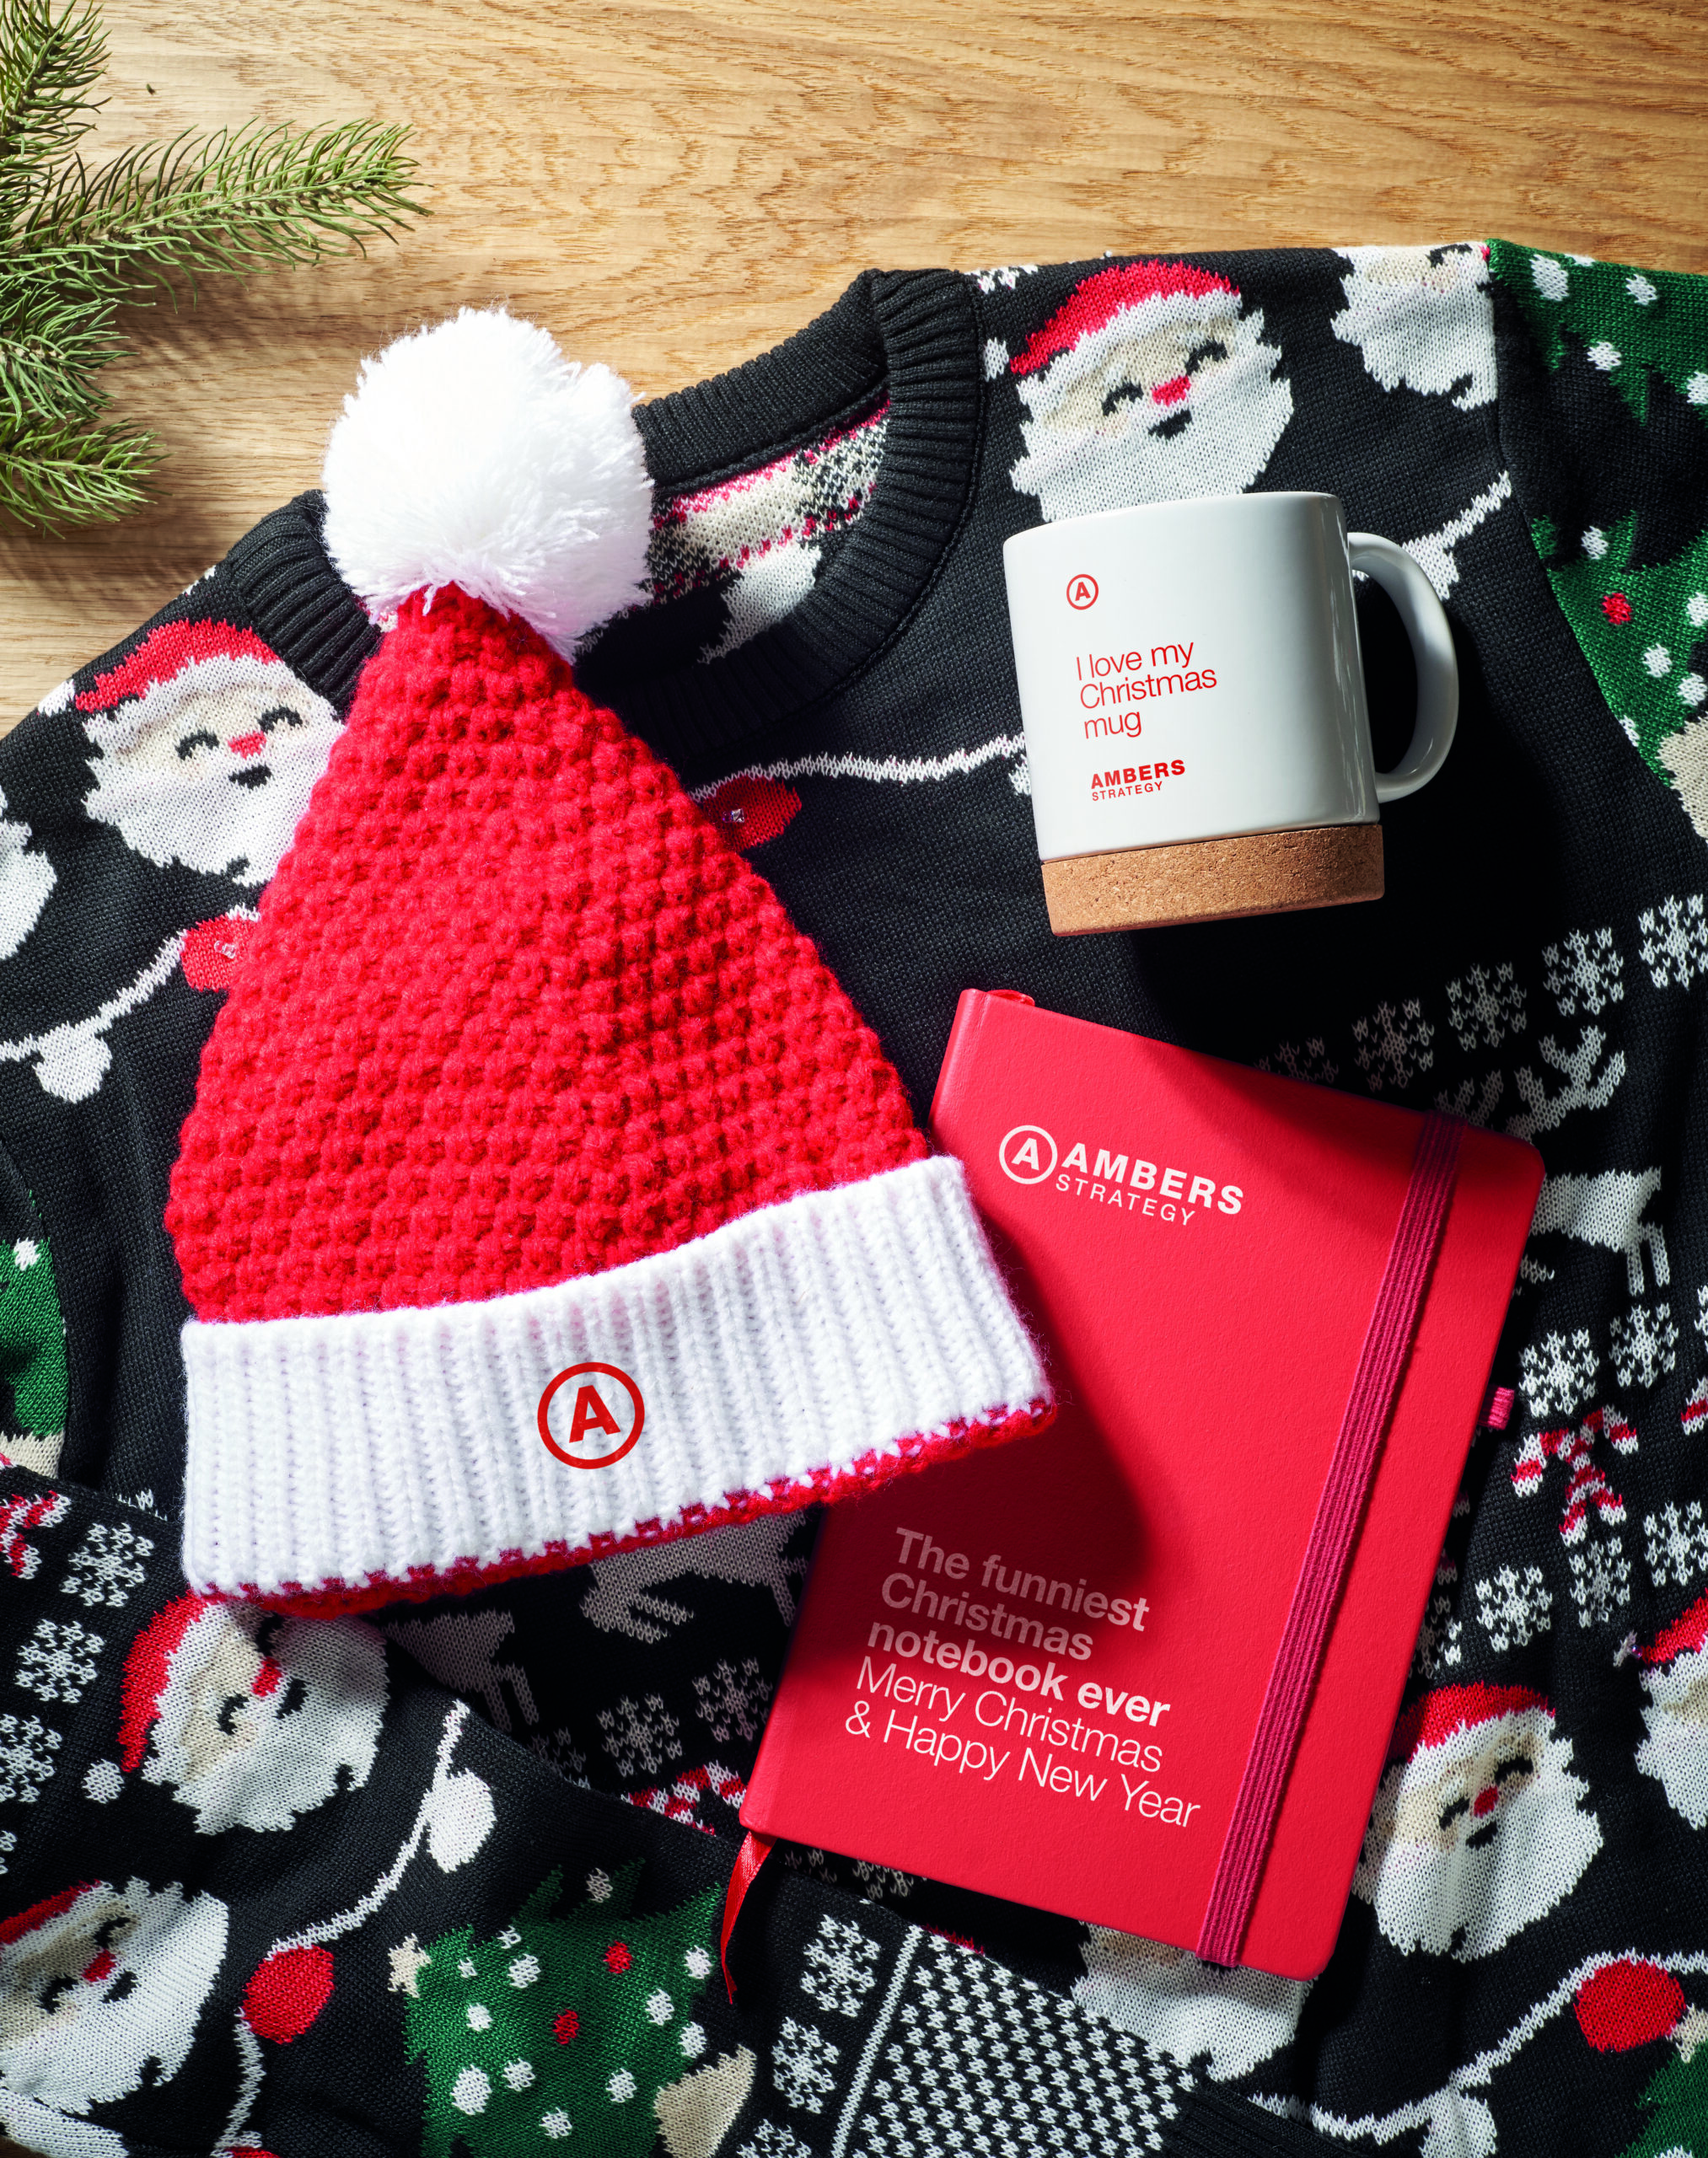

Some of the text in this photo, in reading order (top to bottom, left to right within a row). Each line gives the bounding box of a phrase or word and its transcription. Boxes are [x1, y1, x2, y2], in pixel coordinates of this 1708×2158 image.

[1077, 641, 1195, 680] I love my
[1080, 668, 1217, 709] Christmas
[1084, 711, 1142, 739] mug
[1091, 760, 1186, 790] AMBERS
[1092, 781, 1163, 802] STRATEGY
[1055, 1173, 1195, 1226] STRATEGY
[1061, 1142, 1243, 1215] AMBERS
[895, 1527, 1150, 1632] The funniest
[882, 1572, 1094, 1661] Christmas
[867, 1622, 1171, 1727] notebook ever
[856, 1656, 1163, 1773] Merry Christmas
[845, 1700, 1201, 1828] & Happy New Year
